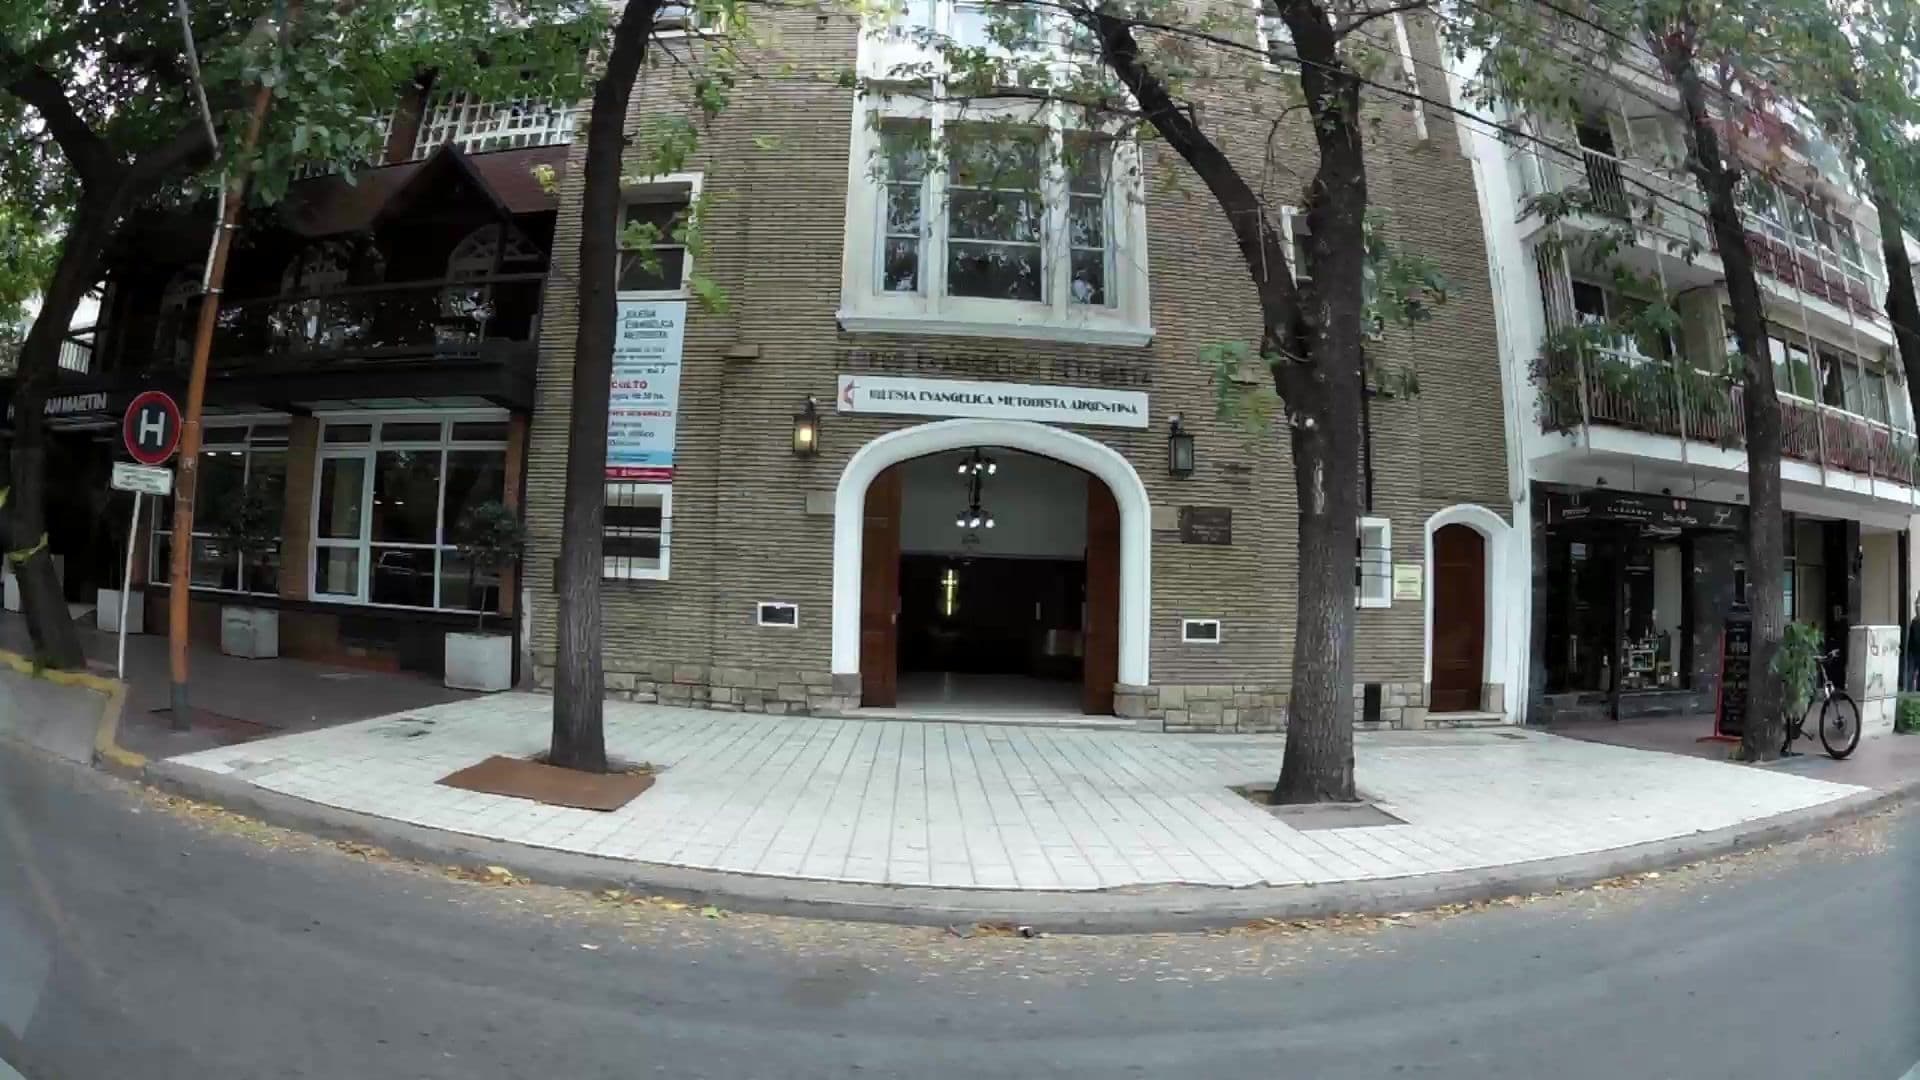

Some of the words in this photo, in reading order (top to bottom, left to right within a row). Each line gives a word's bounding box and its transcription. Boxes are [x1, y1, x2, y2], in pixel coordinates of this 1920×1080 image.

[870, 389, 916, 401] IGLESIA
[920, 391, 994, 405] EVANGELICA
[999, 395, 1067, 409] METODISTA
[1072, 399, 1137, 414] ARGENTINA
[139, 408, 166, 447] H
